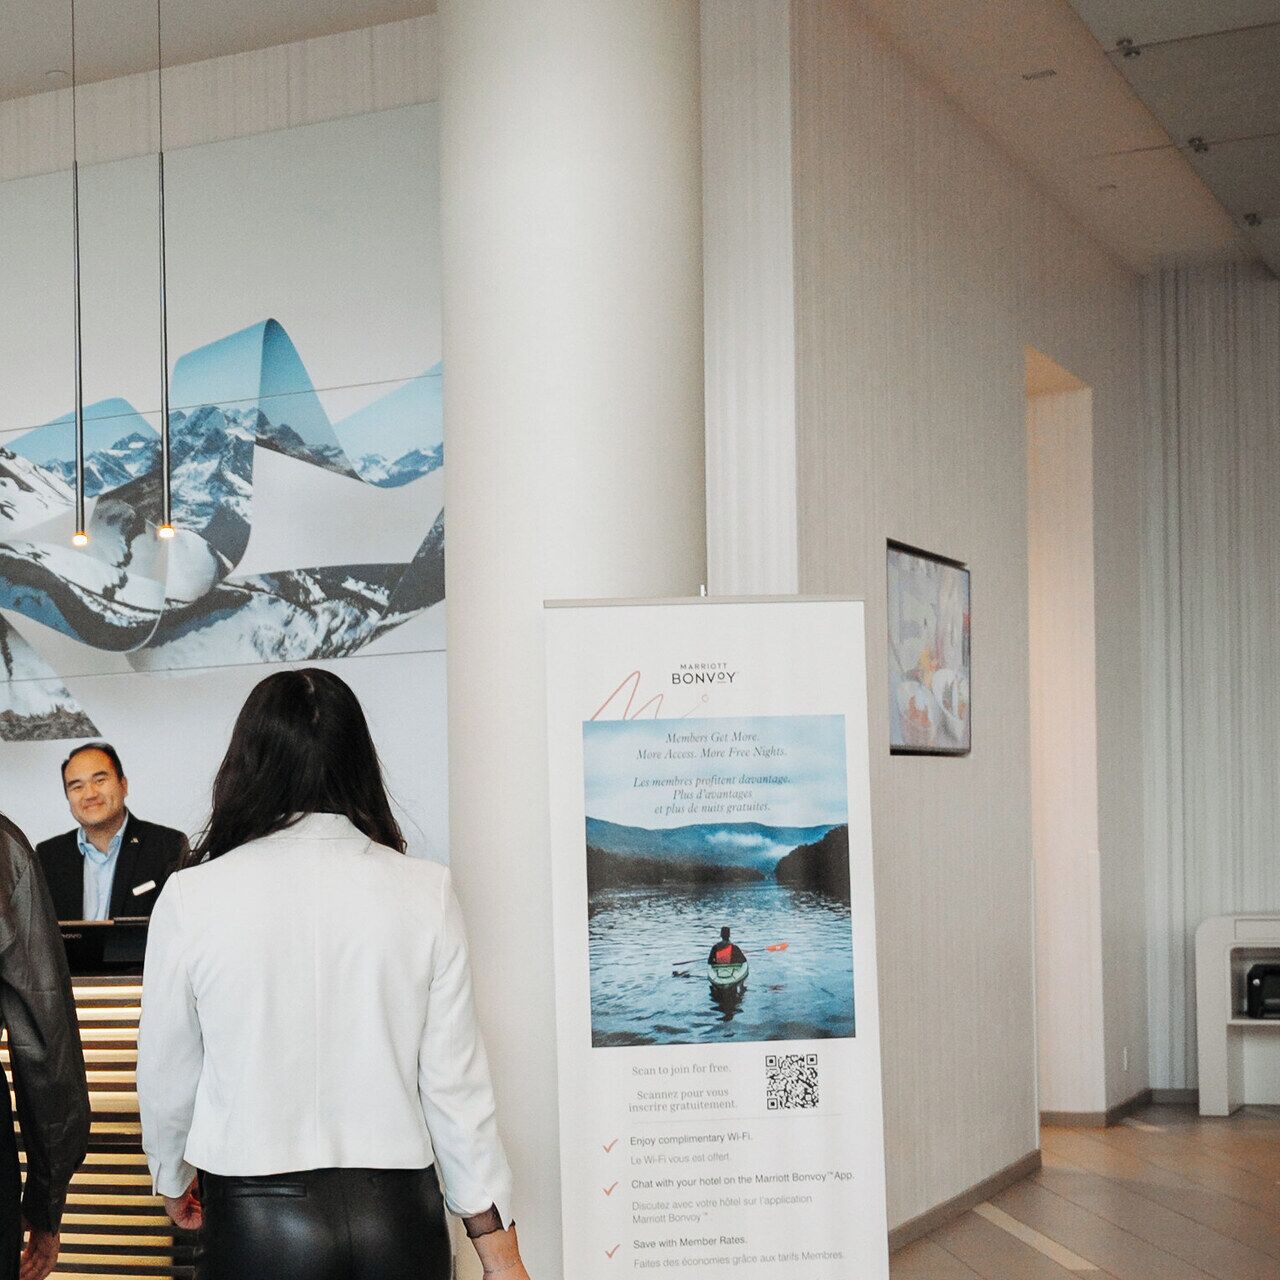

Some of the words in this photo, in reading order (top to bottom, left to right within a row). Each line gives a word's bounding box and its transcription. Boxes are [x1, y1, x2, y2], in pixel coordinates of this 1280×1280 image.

[672, 672, 735, 684] BONVOY
[665, 732, 708, 743] Members
[711, 732, 728, 741] Get
[731, 731, 759, 741] More.
[636, 749, 661, 760] More
[664, 749, 696, 759] Access.
[700, 748, 725, 758] More
[729, 747, 750, 757] Free
[753, 746, 787, 757] Nights.
[633, 777, 649, 787] Les
[652, 776, 692, 786] membres
[695, 775, 735, 787] profitent
[738, 774, 791, 786] davantage.
[673, 790, 693, 800] Plus
[654, 804, 663, 814] et
[666, 803, 684, 815] plus
[688, 803, 699, 813] de
[702, 803, 724, 812] nuits
[727, 802, 770, 813] gratuites.
[632, 1067, 656, 1075] Scan
[670, 1066, 690, 1076] join
[693, 1064, 707, 1073] for
[709, 1063, 732, 1072] free.
[637, 1090, 678, 1099] Scannez
[681, 1090, 703, 1100] pour
[629, 1103, 667, 1112] inscrire
[670, 1100, 737, 1113] gratuitement.
[630, 1136, 655, 1148] Enjoy
[658, 1134, 724, 1145] complimentary
[728, 1132, 753, 1141] Wi-Fi.
[631, 1156, 641, 1165] Le
[644, 1155, 666, 1165] Wi-Fi
[668, 1155, 689, 1163] vous
[692, 1154, 705, 1162] est
[708, 1153, 731, 1162] offert.
[632, 1180, 653, 1189] Chat
[656, 1178, 674, 1187] with
[677, 1179, 696, 1189] your
[700, 1177, 721, 1185] hotel
[738, 1175, 752, 1183] the
[755, 1173, 789, 1183] Marriott
[632, 1201, 669, 1210] Discutez
[672, 1201, 693, 1209] avec
[696, 1199, 717, 1208] votre
[720, 1197, 741, 1206] hôtel
[633, 1214, 666, 1223] Marriott
[633, 1240, 656, 1249] Save
[659, 1239, 677, 1248] with
[680, 1237, 717, 1246] Member
[720, 1236, 747, 1244] Rates.
[634, 1259, 661, 1268] Faites
[663, 1258, 679, 1267] des
[682, 1257, 730, 1266] économies
[733, 1255, 757, 1266] grâce
[778, 1252, 799, 1261] tarifs
